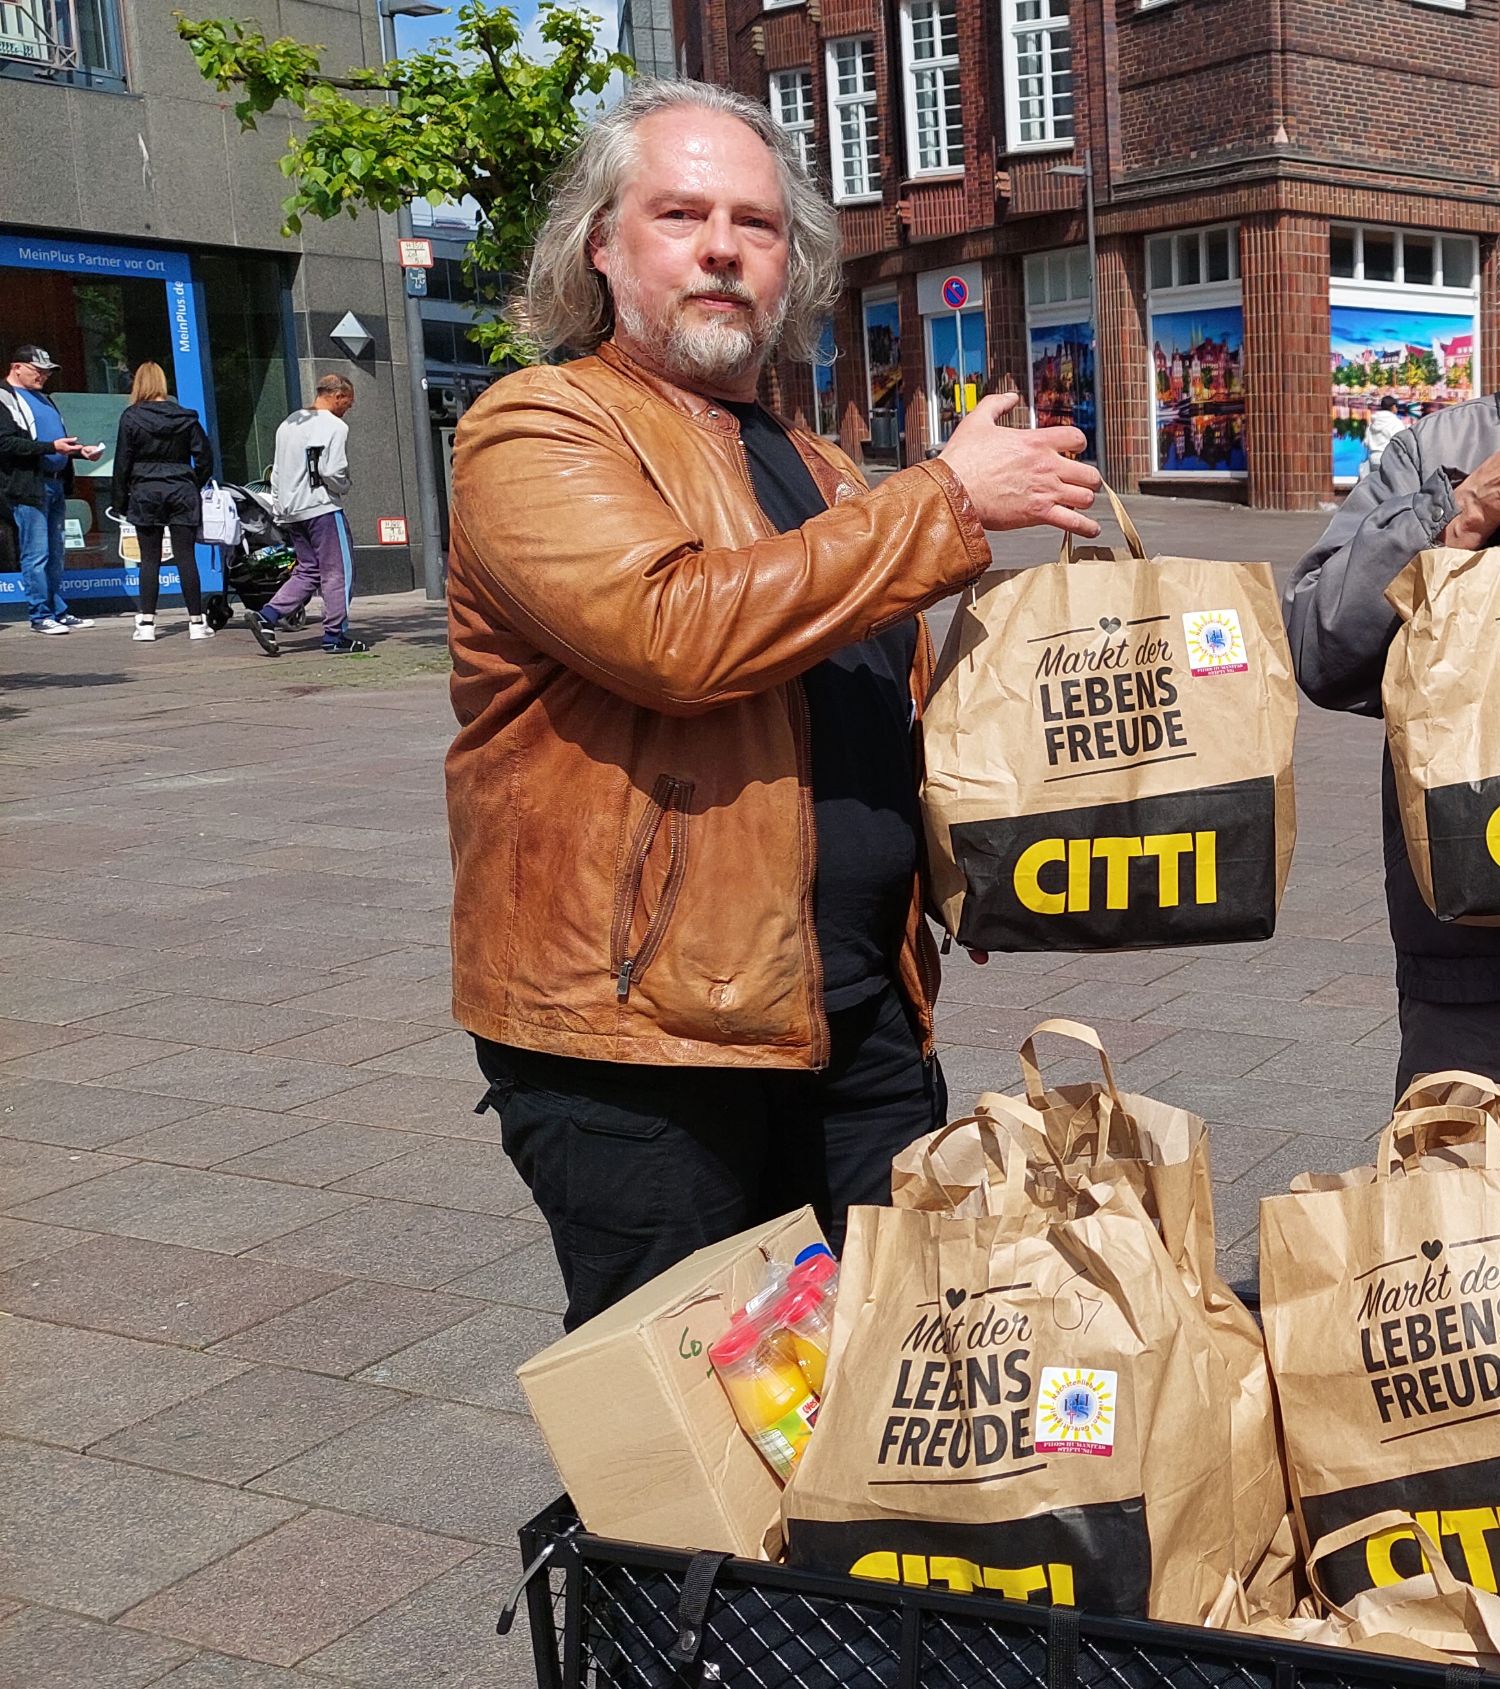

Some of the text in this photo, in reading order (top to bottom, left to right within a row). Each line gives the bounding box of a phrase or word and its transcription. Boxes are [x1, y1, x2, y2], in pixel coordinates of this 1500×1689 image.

[19, 248, 165, 272] MeinPlus Partner vor Ort
[173, 280, 190, 353] MeinPlus.de
[0, 580, 15, 592] ite
[1035, 635, 1130, 680] Markt
[1135, 632, 1173, 667] der
[1039, 666, 1178, 723] LEBENS
[1044, 709, 1188, 766] FREUDE
[1013, 830, 1218, 915] CITTI
[1357, 1262, 1452, 1322] Markt
[966, 1305, 1032, 1350] der
[877, 1407, 1036, 1469] FREUDE
